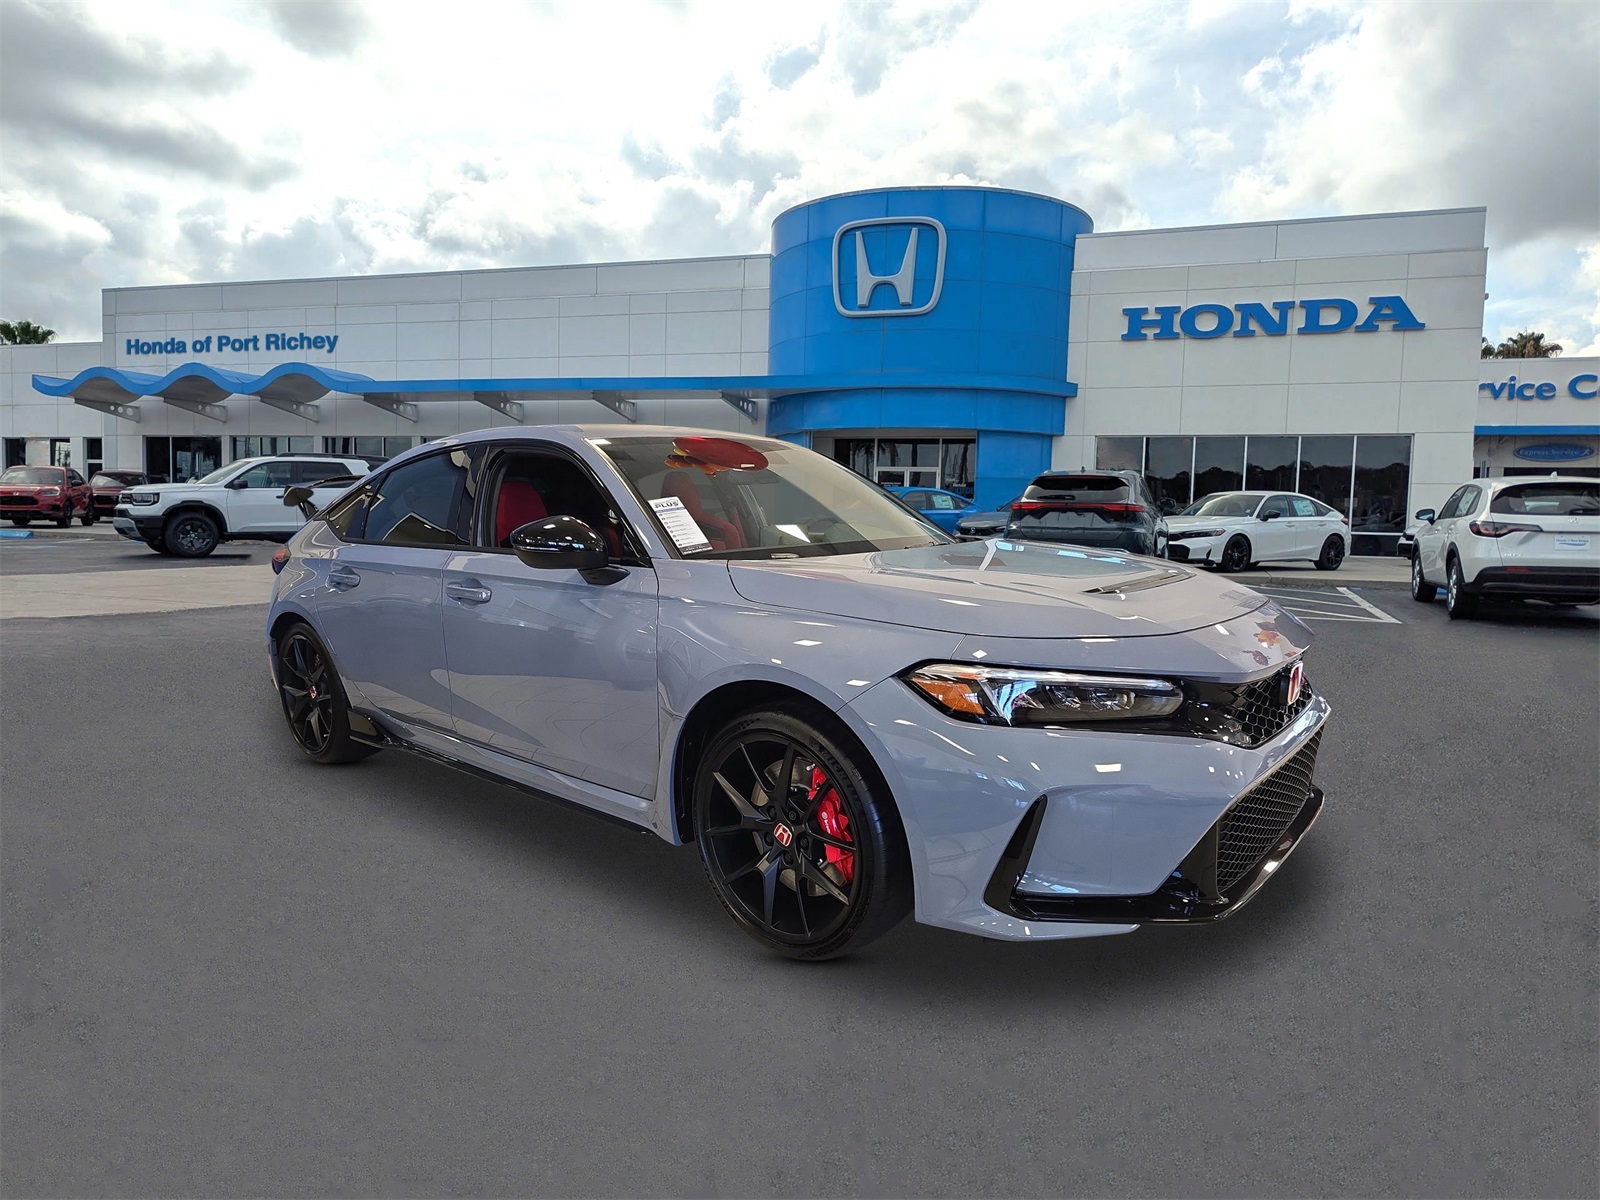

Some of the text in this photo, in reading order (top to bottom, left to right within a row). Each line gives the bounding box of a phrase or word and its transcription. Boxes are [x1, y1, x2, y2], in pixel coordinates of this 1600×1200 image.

[1120, 295, 1427, 341] HONDA
[125, 332, 339, 355] Honda of Port Richey
